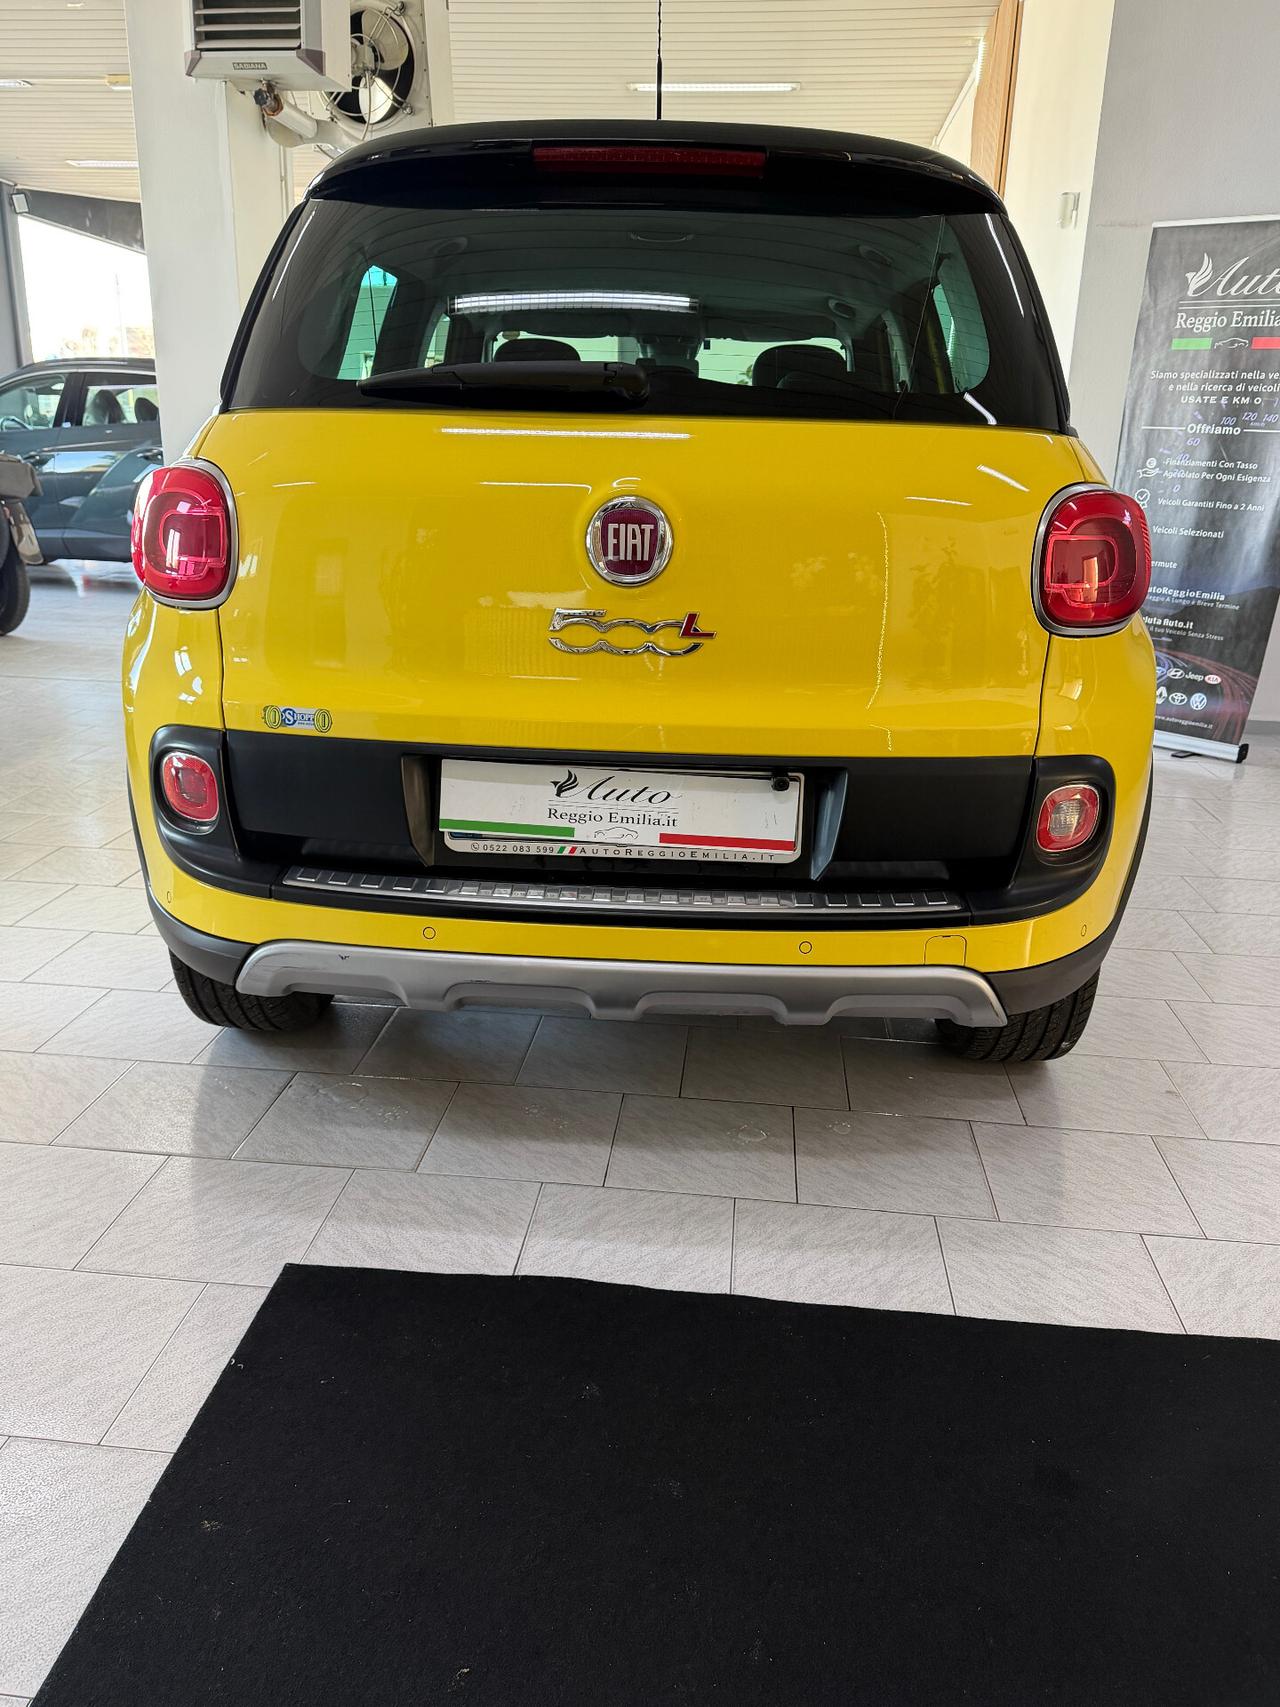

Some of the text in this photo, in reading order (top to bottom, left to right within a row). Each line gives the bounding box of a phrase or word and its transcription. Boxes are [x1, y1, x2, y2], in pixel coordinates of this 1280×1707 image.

[1174, 312, 1228, 333] Reggio
[1150, 369, 1280, 380] Siamo specializzati nella ve
[1176, 382, 1199, 391] nella
[1201, 382, 1233, 392] ricerca
[1235, 382, 1246, 392] di
[1247, 383, 1280, 392] veicoli
[1180, 395, 1218, 404] USATE
[1220, 396, 1229, 404] E
[1232, 396, 1250, 405] KM
[1242, 412, 1258, 421] 120
[1187, 423, 1241, 435] Offriamo
[1218, 460, 1235, 469] Con
[1236, 460, 1258, 470] Tasso
[1201, 472, 1215, 480] Per
[1216, 472, 1235, 482] Ogni
[1236, 473, 1271, 484] Esigenza
[1158, 497, 1181, 506] Veicoli
[1182, 498, 1215, 508] Garantiti
[1215, 501, 1233, 510] Fino
[1239, 502, 1246, 511] 2
[1246, 503, 1265, 512] Anni
[1152, 525, 1225, 539] Veicoli Selezionati
[607, 523, 654, 561] FIAT
[1151, 560, 1178, 569] ermute
[1147, 586, 1226, 601] utoReggioEmilia
[1185, 671, 1204, 682] Jeep
[564, 775, 679, 804] Auto
[547, 807, 678, 827] Reggio Emilia.it
[482, 844, 507, 852] 0522
[512, 845, 531, 853] 083
[536, 846, 554, 854] 599
